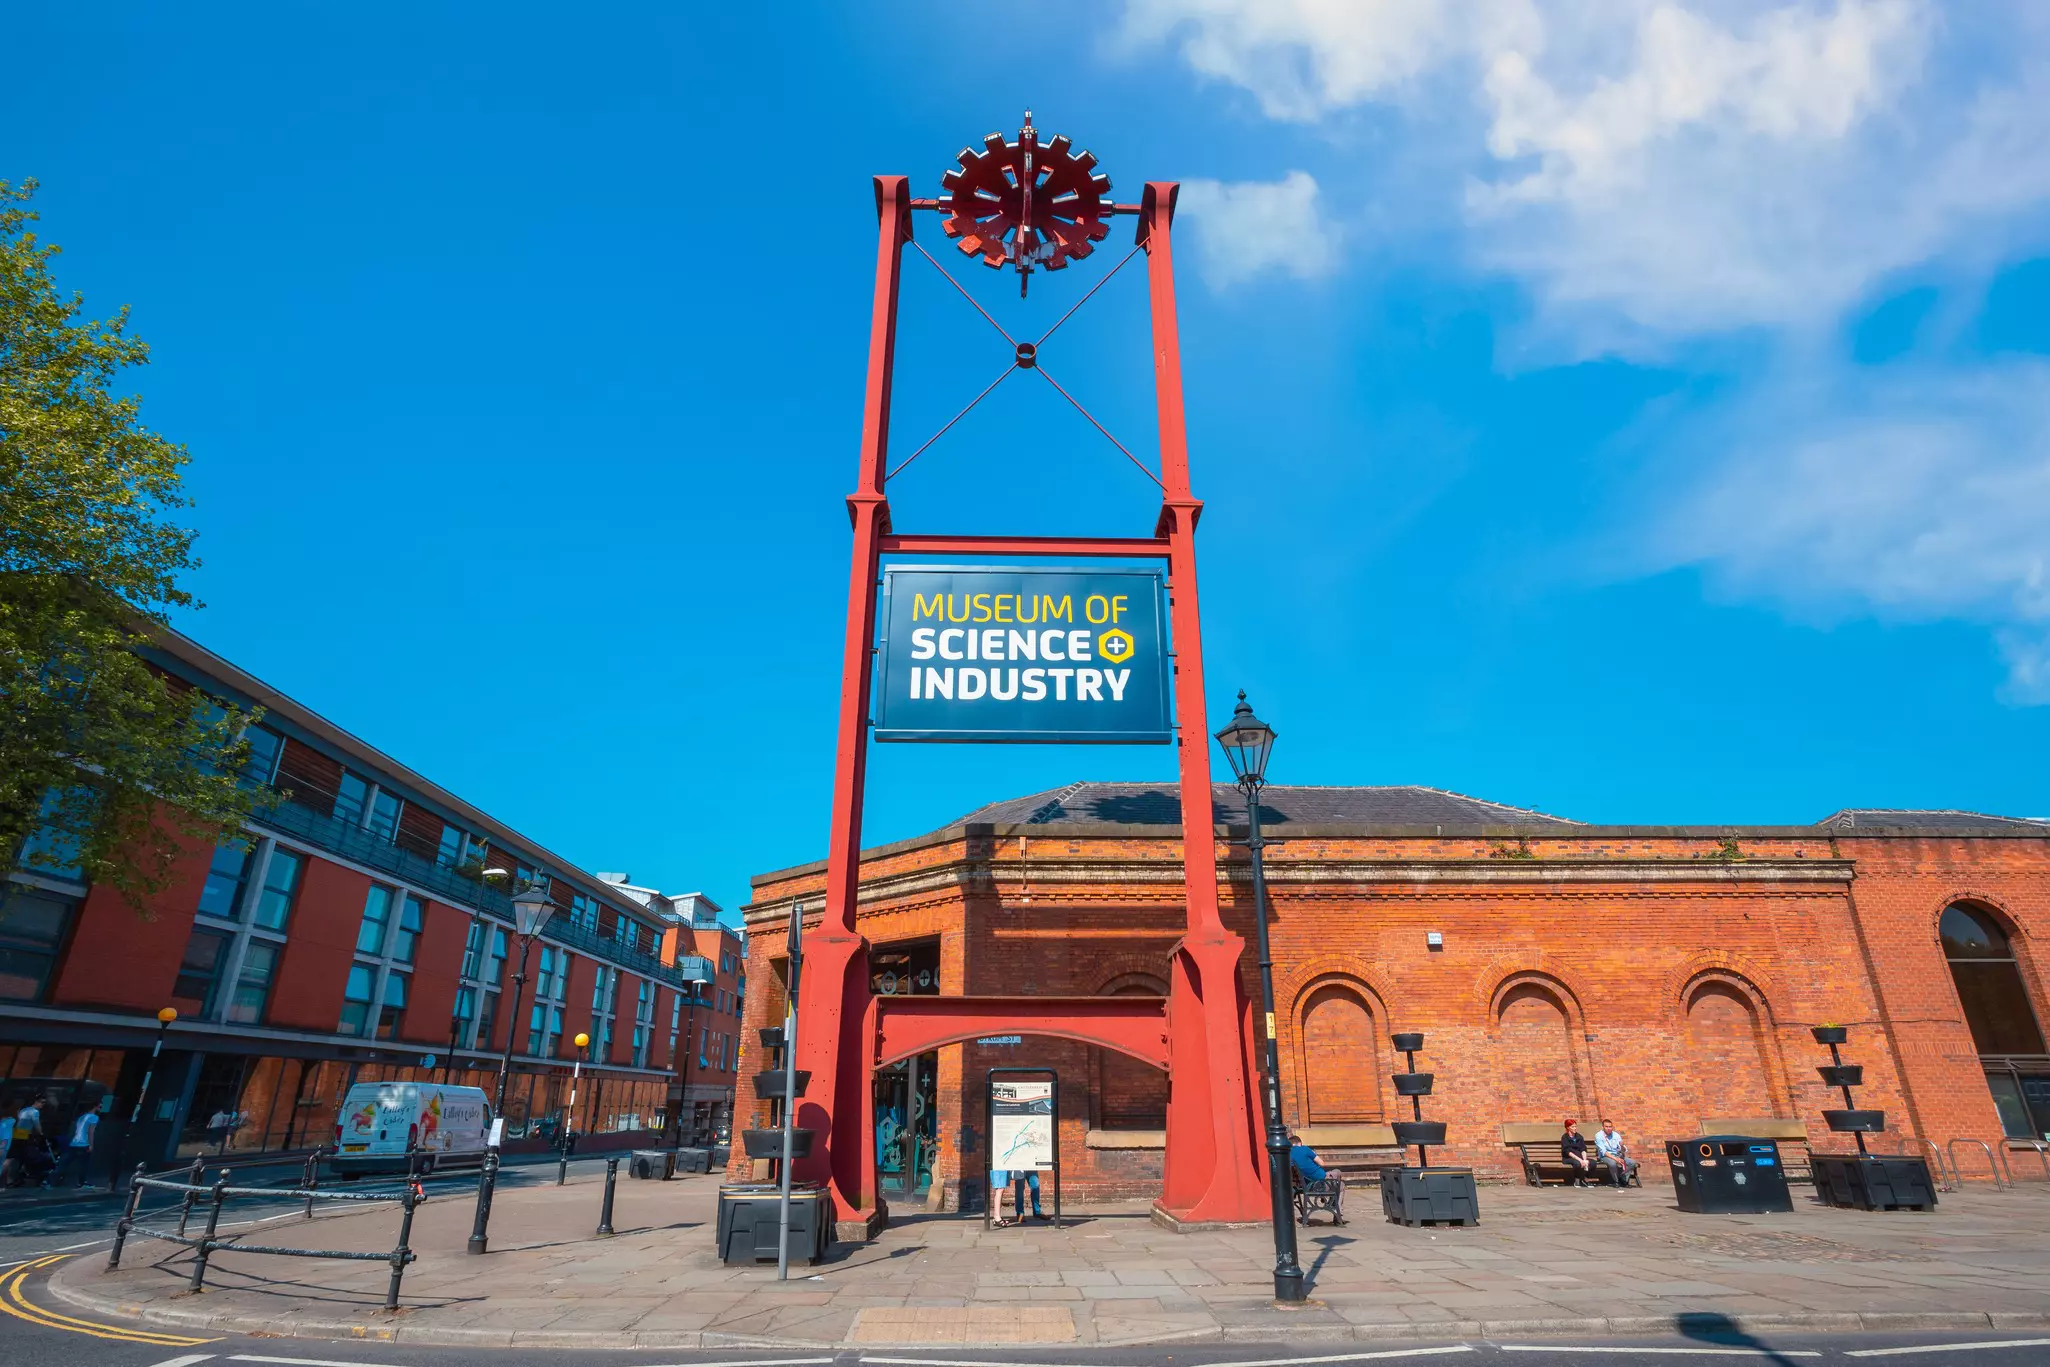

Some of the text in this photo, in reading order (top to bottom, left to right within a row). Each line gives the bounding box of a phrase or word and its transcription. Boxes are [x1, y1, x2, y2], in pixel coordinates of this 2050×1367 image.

[912, 593, 1128, 624] MUSEUM OF
[911, 628, 1091, 661] SCIENCE
[910, 667, 1131, 702] INDUSTRY
